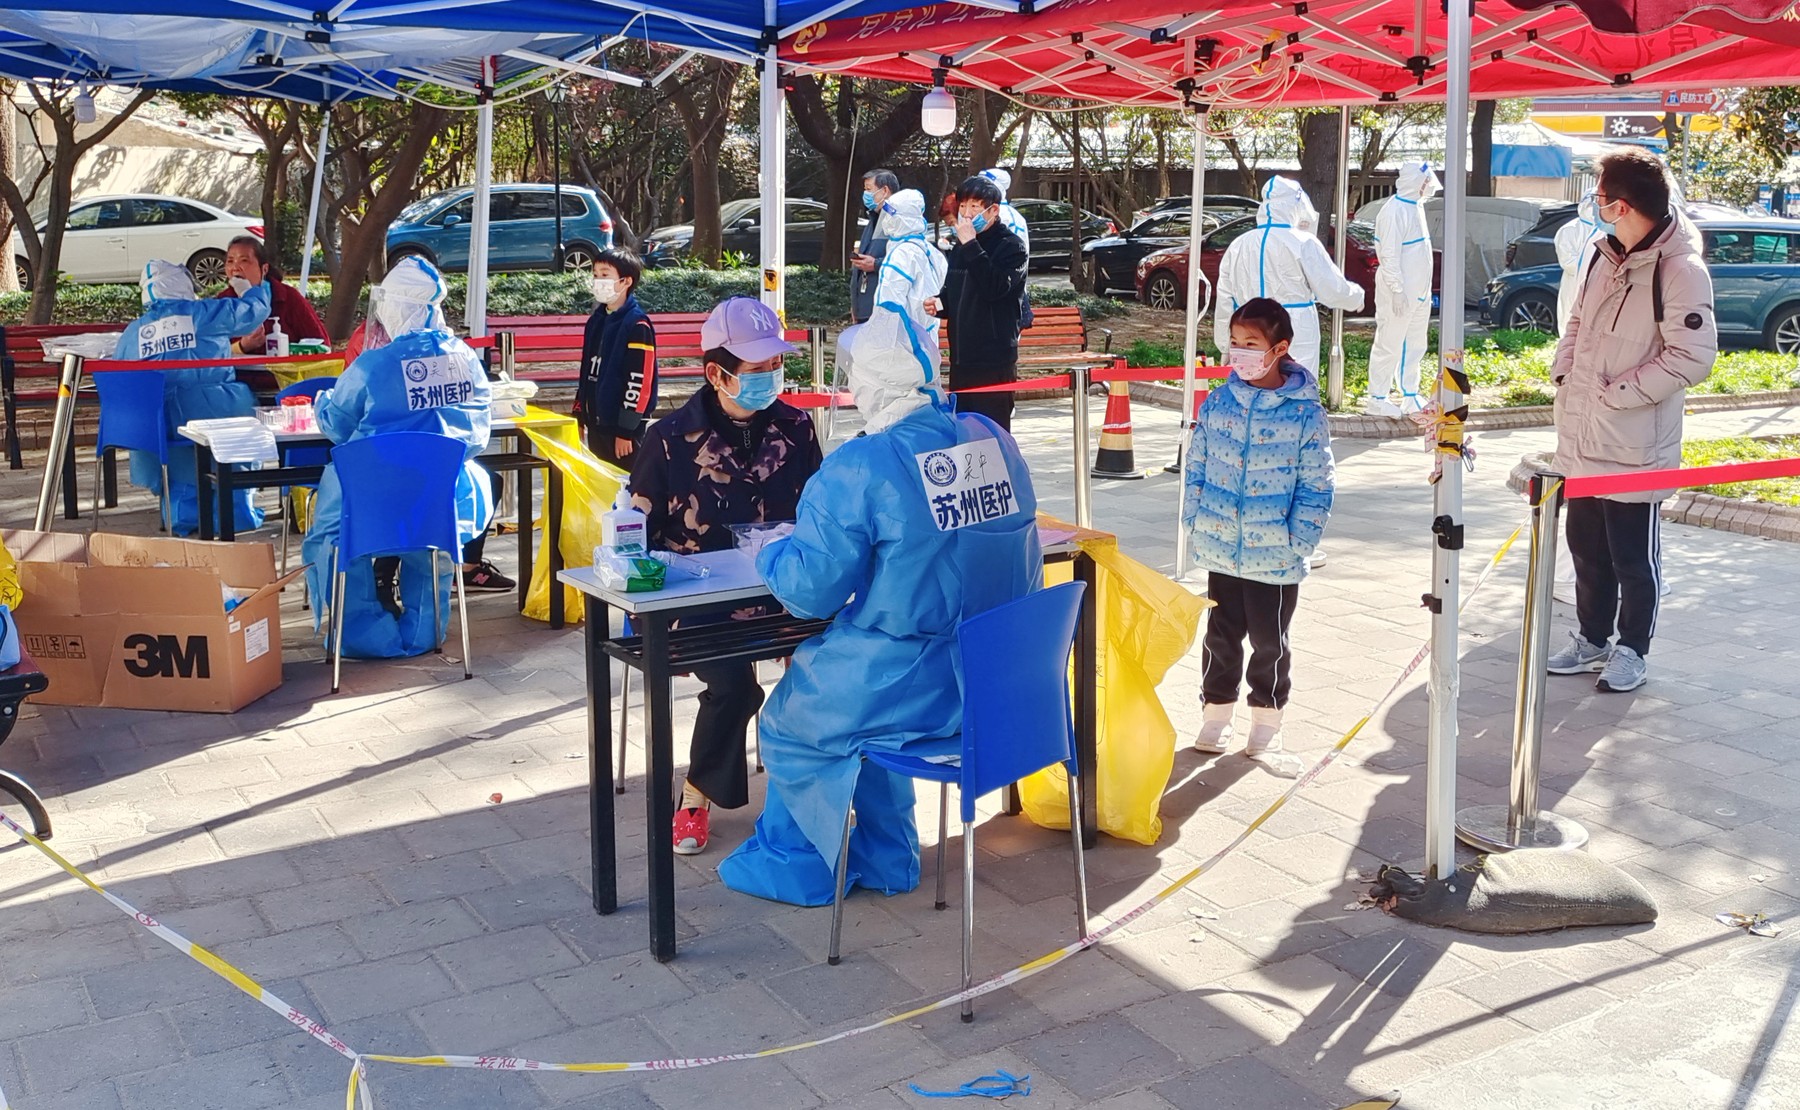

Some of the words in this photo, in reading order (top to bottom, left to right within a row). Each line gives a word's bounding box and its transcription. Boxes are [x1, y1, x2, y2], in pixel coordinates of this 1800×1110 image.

[1680, 92, 1712, 104] 民防工程
[141, 332, 194, 356] 苏州医护
[409, 380, 472, 410] 苏州医护
[623, 372, 645, 409] 1911
[932, 480, 1013, 531] 苏州医护
[124, 634, 210, 679] 3M
